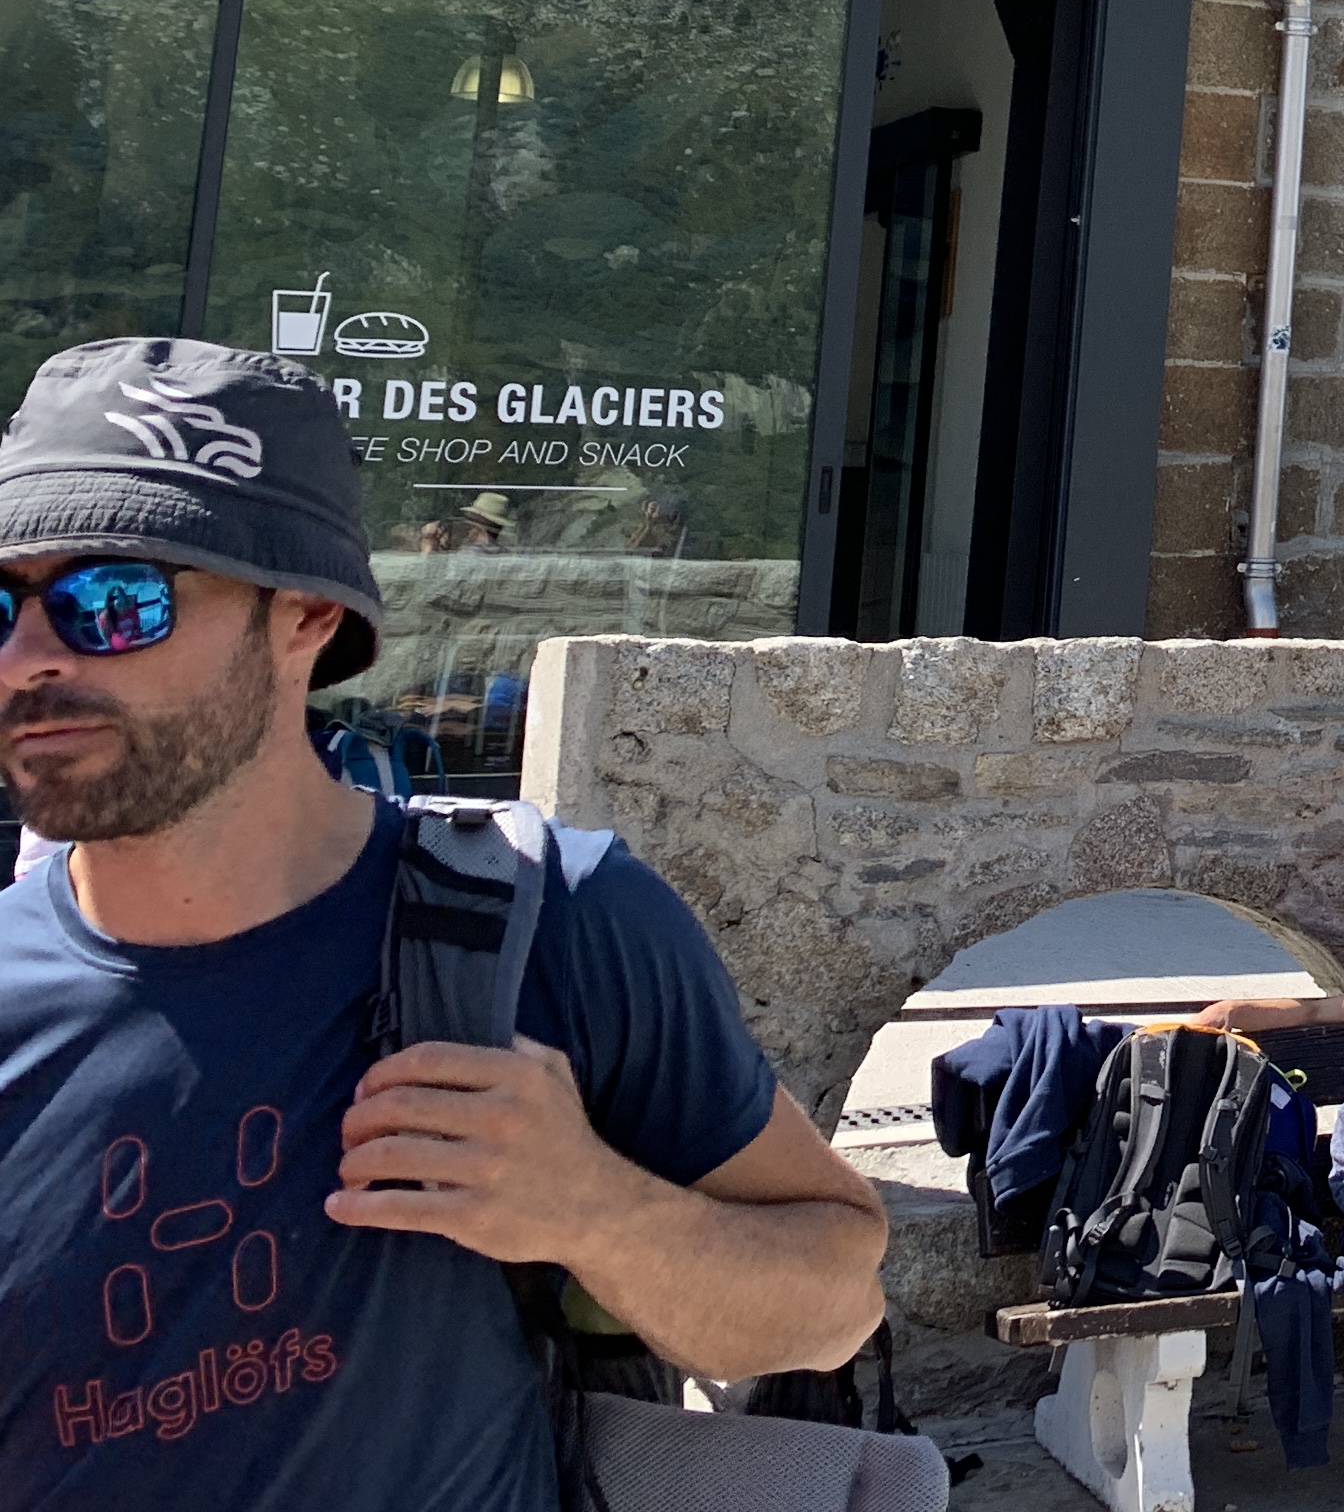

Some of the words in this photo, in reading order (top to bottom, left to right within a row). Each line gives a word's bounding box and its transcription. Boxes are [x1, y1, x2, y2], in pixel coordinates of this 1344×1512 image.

[383, 380, 477, 423] DES
[497, 383, 725, 429] GLACIERS
[397, 437, 493, 463] SHOP
[498, 440, 569, 465] AND
[579, 441, 690, 468] SNACK
[54, 1328, 339, 1448] Haglöfs
